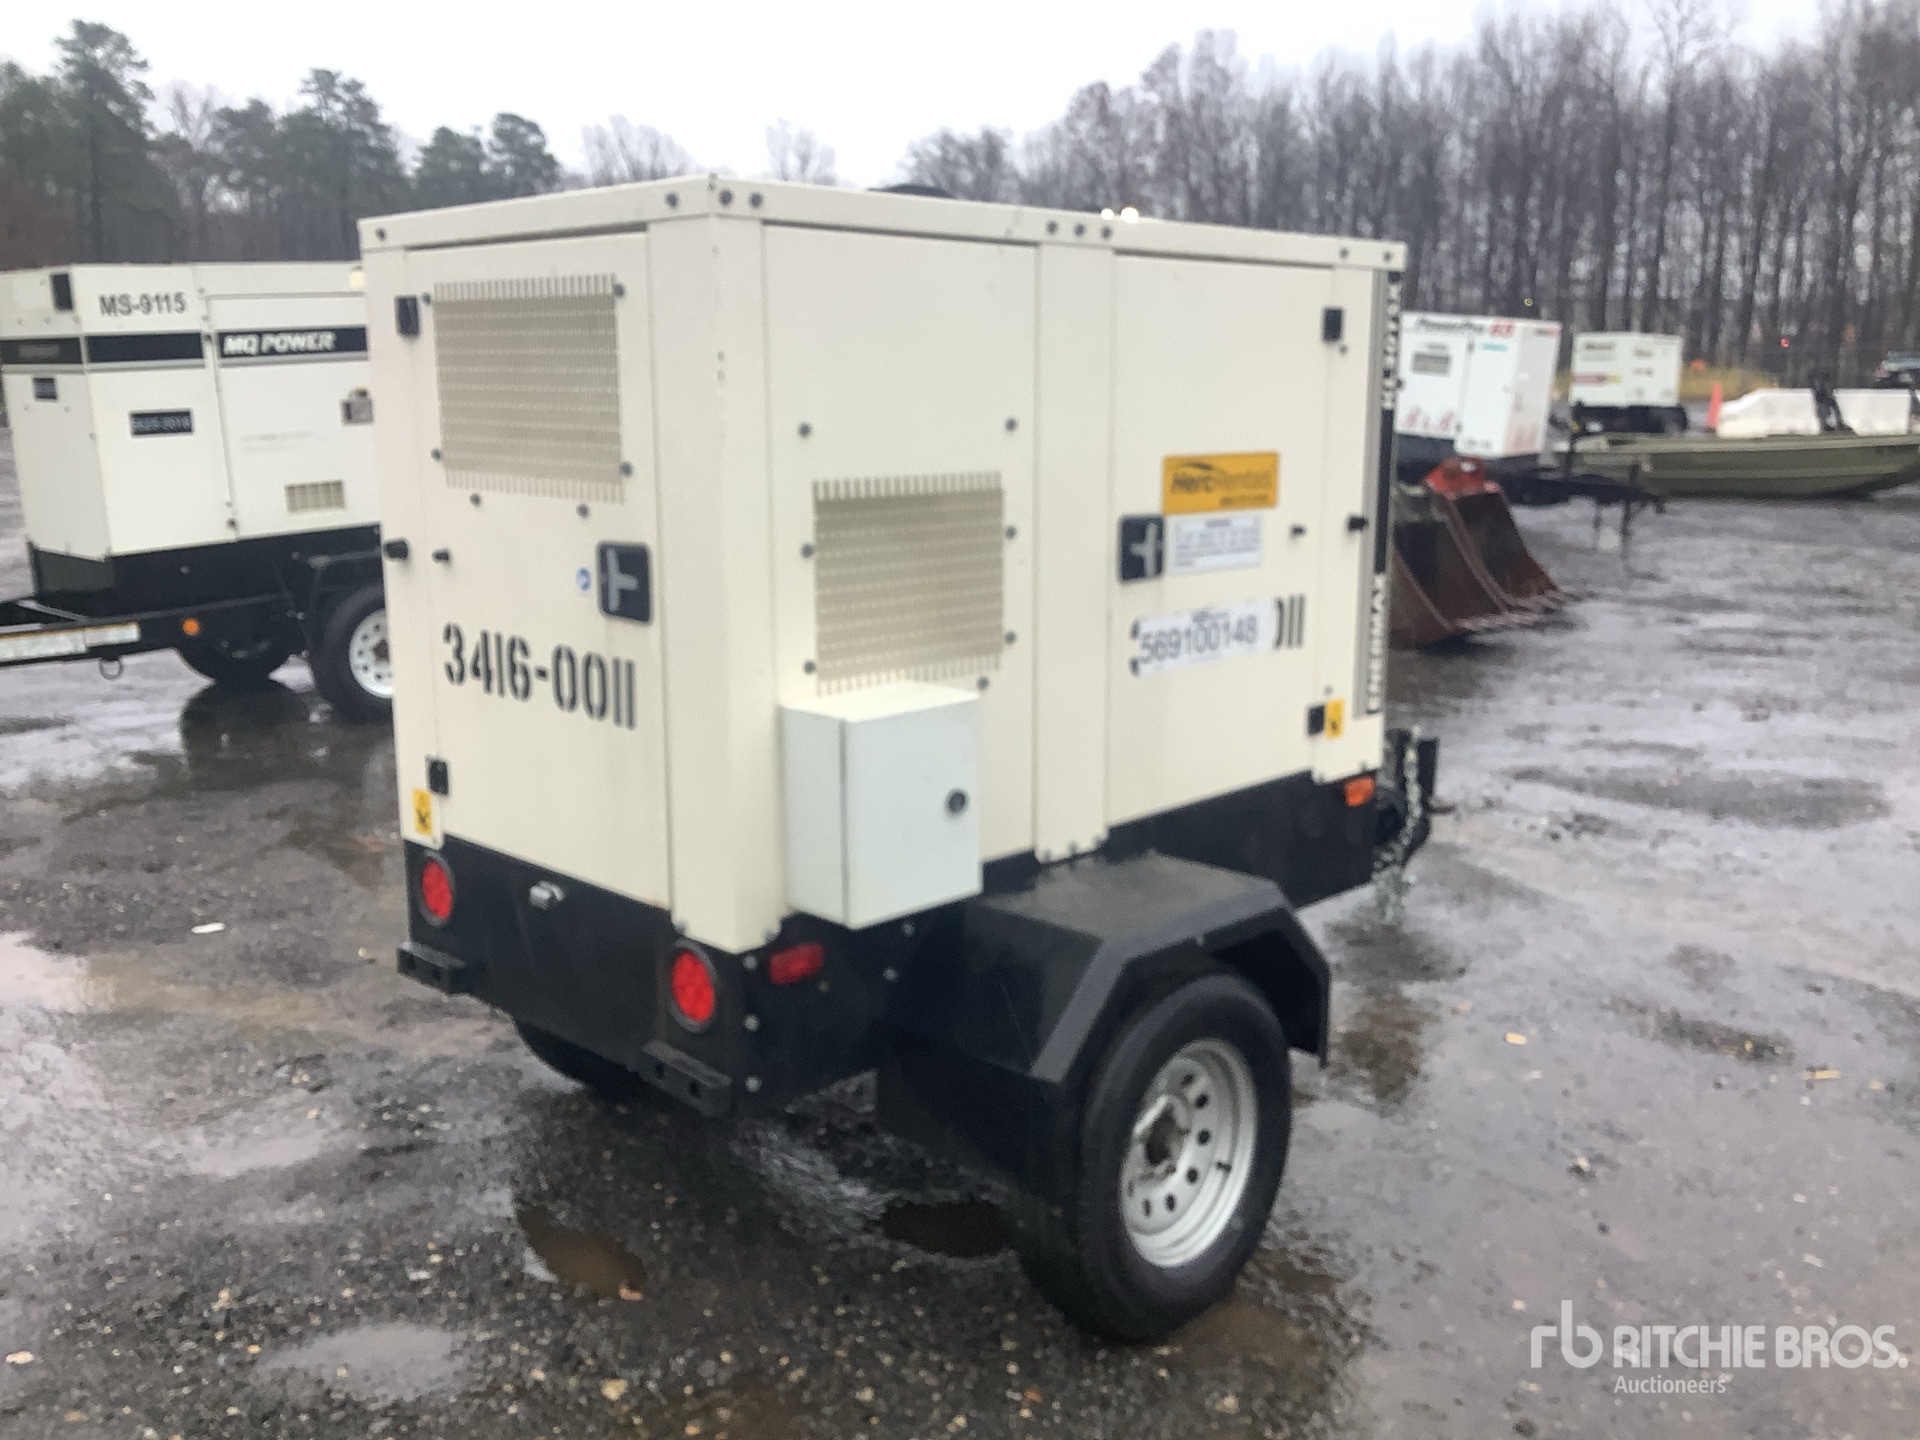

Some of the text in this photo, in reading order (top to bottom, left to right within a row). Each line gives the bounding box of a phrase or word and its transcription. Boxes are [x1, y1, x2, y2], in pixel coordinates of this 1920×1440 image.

[99, 292, 187, 317] MS-9115
[223, 331, 336, 356] MQ POWER
[1138, 614, 1257, 664] 569100148
[443, 622, 635, 730] 3416-0011
